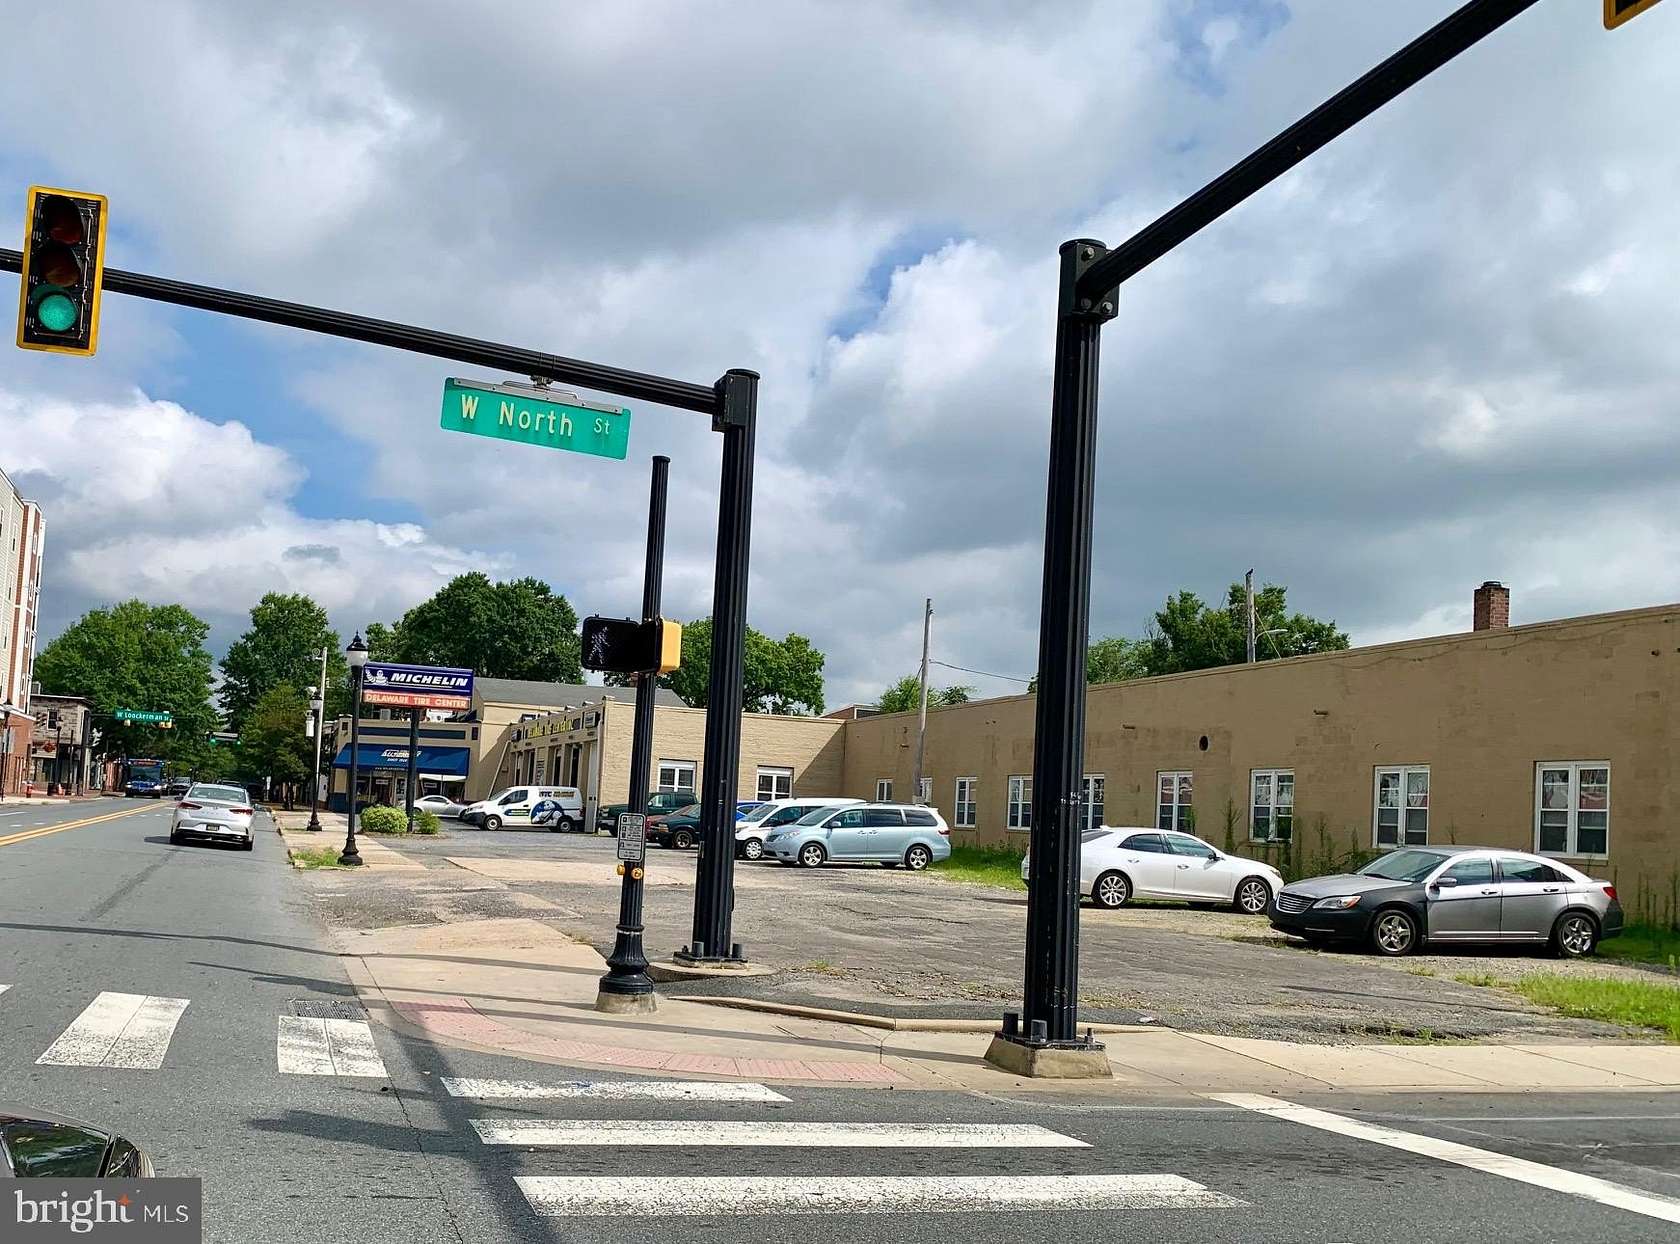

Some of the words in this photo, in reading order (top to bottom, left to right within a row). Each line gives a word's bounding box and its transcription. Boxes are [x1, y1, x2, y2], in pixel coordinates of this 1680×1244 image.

[461, 394, 479, 420] W
[499, 401, 573, 437] North
[594, 417, 611, 435] St
[391, 673, 468, 687] MICHELIN
[366, 693, 408, 704] DELAWARE
[414, 696, 430, 706] TIRE
[435, 698, 467, 709] CENTER
